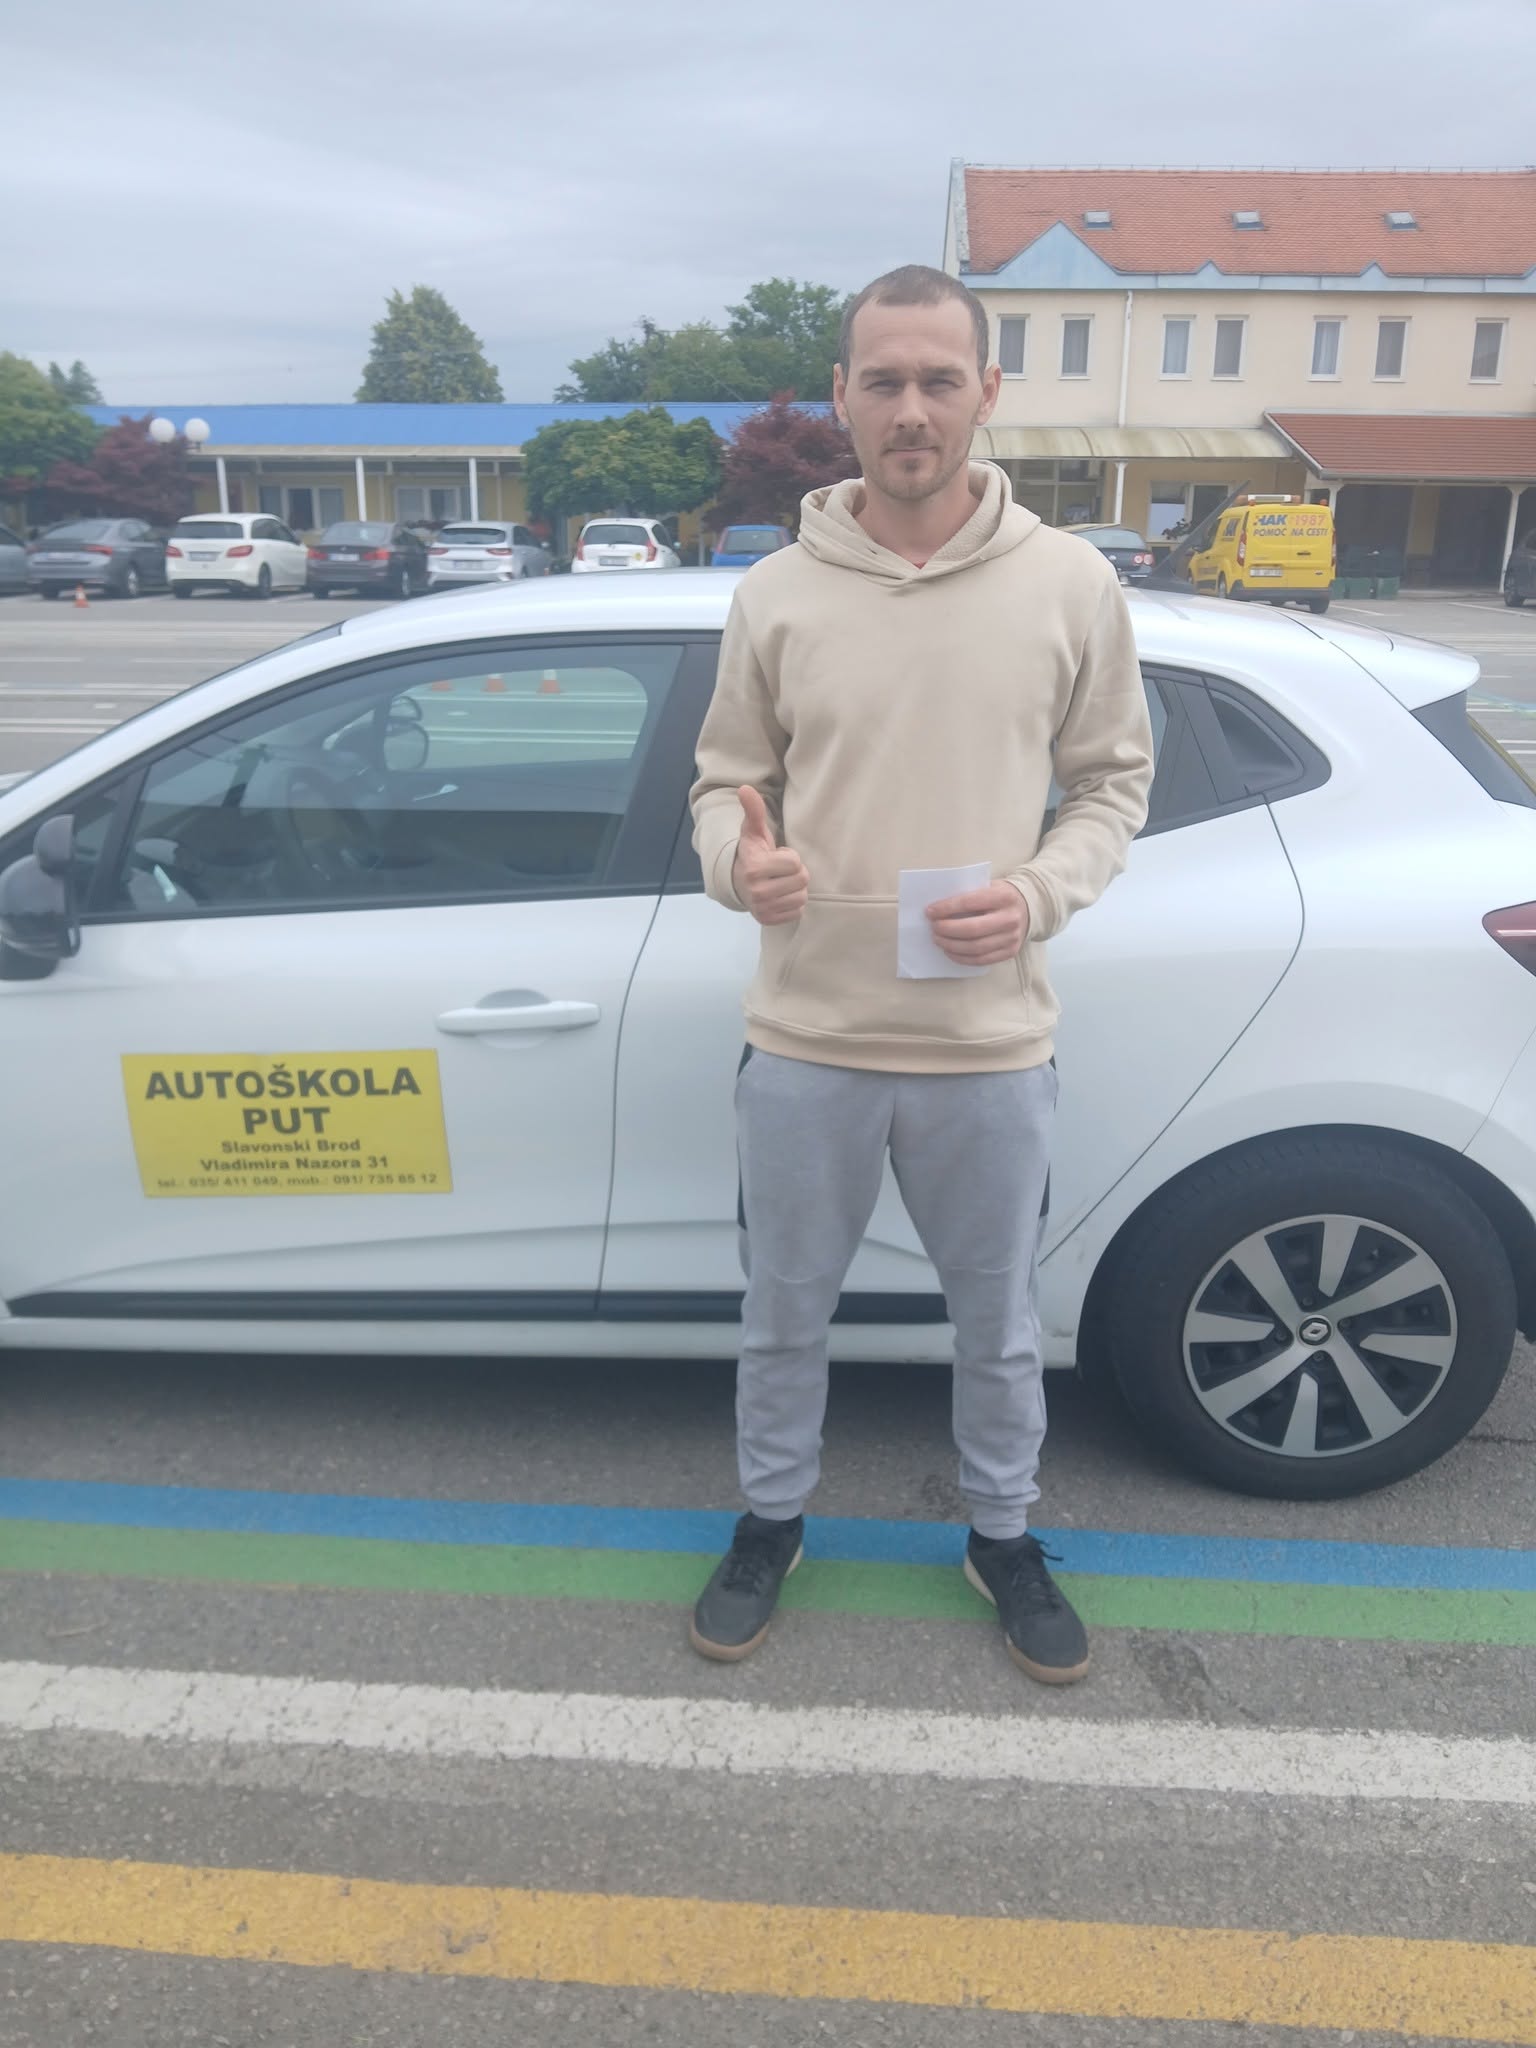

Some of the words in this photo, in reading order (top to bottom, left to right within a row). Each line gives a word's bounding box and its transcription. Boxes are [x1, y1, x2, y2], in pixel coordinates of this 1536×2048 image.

[1294, 514, 1326, 526] 1987
[1291, 527, 1304, 537] NA
[1306, 527, 1328, 537] CESTI
[145, 1063, 421, 1099] AUTOŠKOLA
[242, 1106, 331, 1135] PUT
[221, 1140, 311, 1154] Slavonski
[317, 1138, 361, 1152] Brod
[200, 1158, 290, 1172] Vladimira
[296, 1157, 361, 1170] Nazora
[367, 1155, 389, 1169] 31
[421, 1172, 438, 1183] 12
